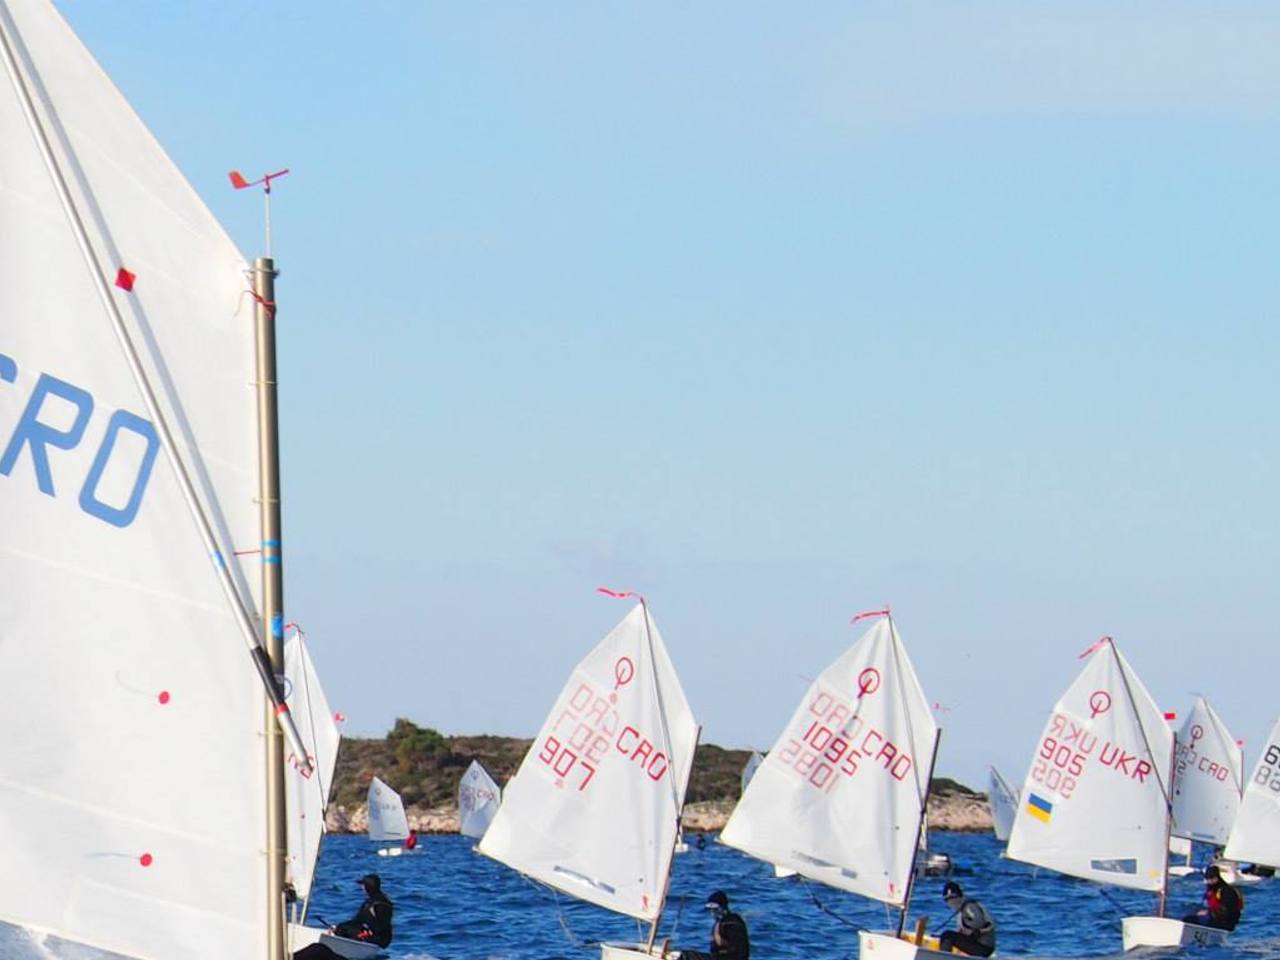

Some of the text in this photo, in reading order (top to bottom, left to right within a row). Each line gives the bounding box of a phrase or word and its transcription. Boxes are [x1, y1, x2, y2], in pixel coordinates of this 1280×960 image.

[538, 736, 595, 791] 907
[615, 726, 667, 781] CRO
[803, 721, 861, 776] 1095
[861, 730, 911, 781] CRO
[1040, 737, 1087, 776] 905
[1099, 742, 1151, 783] UKR
[1198, 757, 1229, 781] CRO
